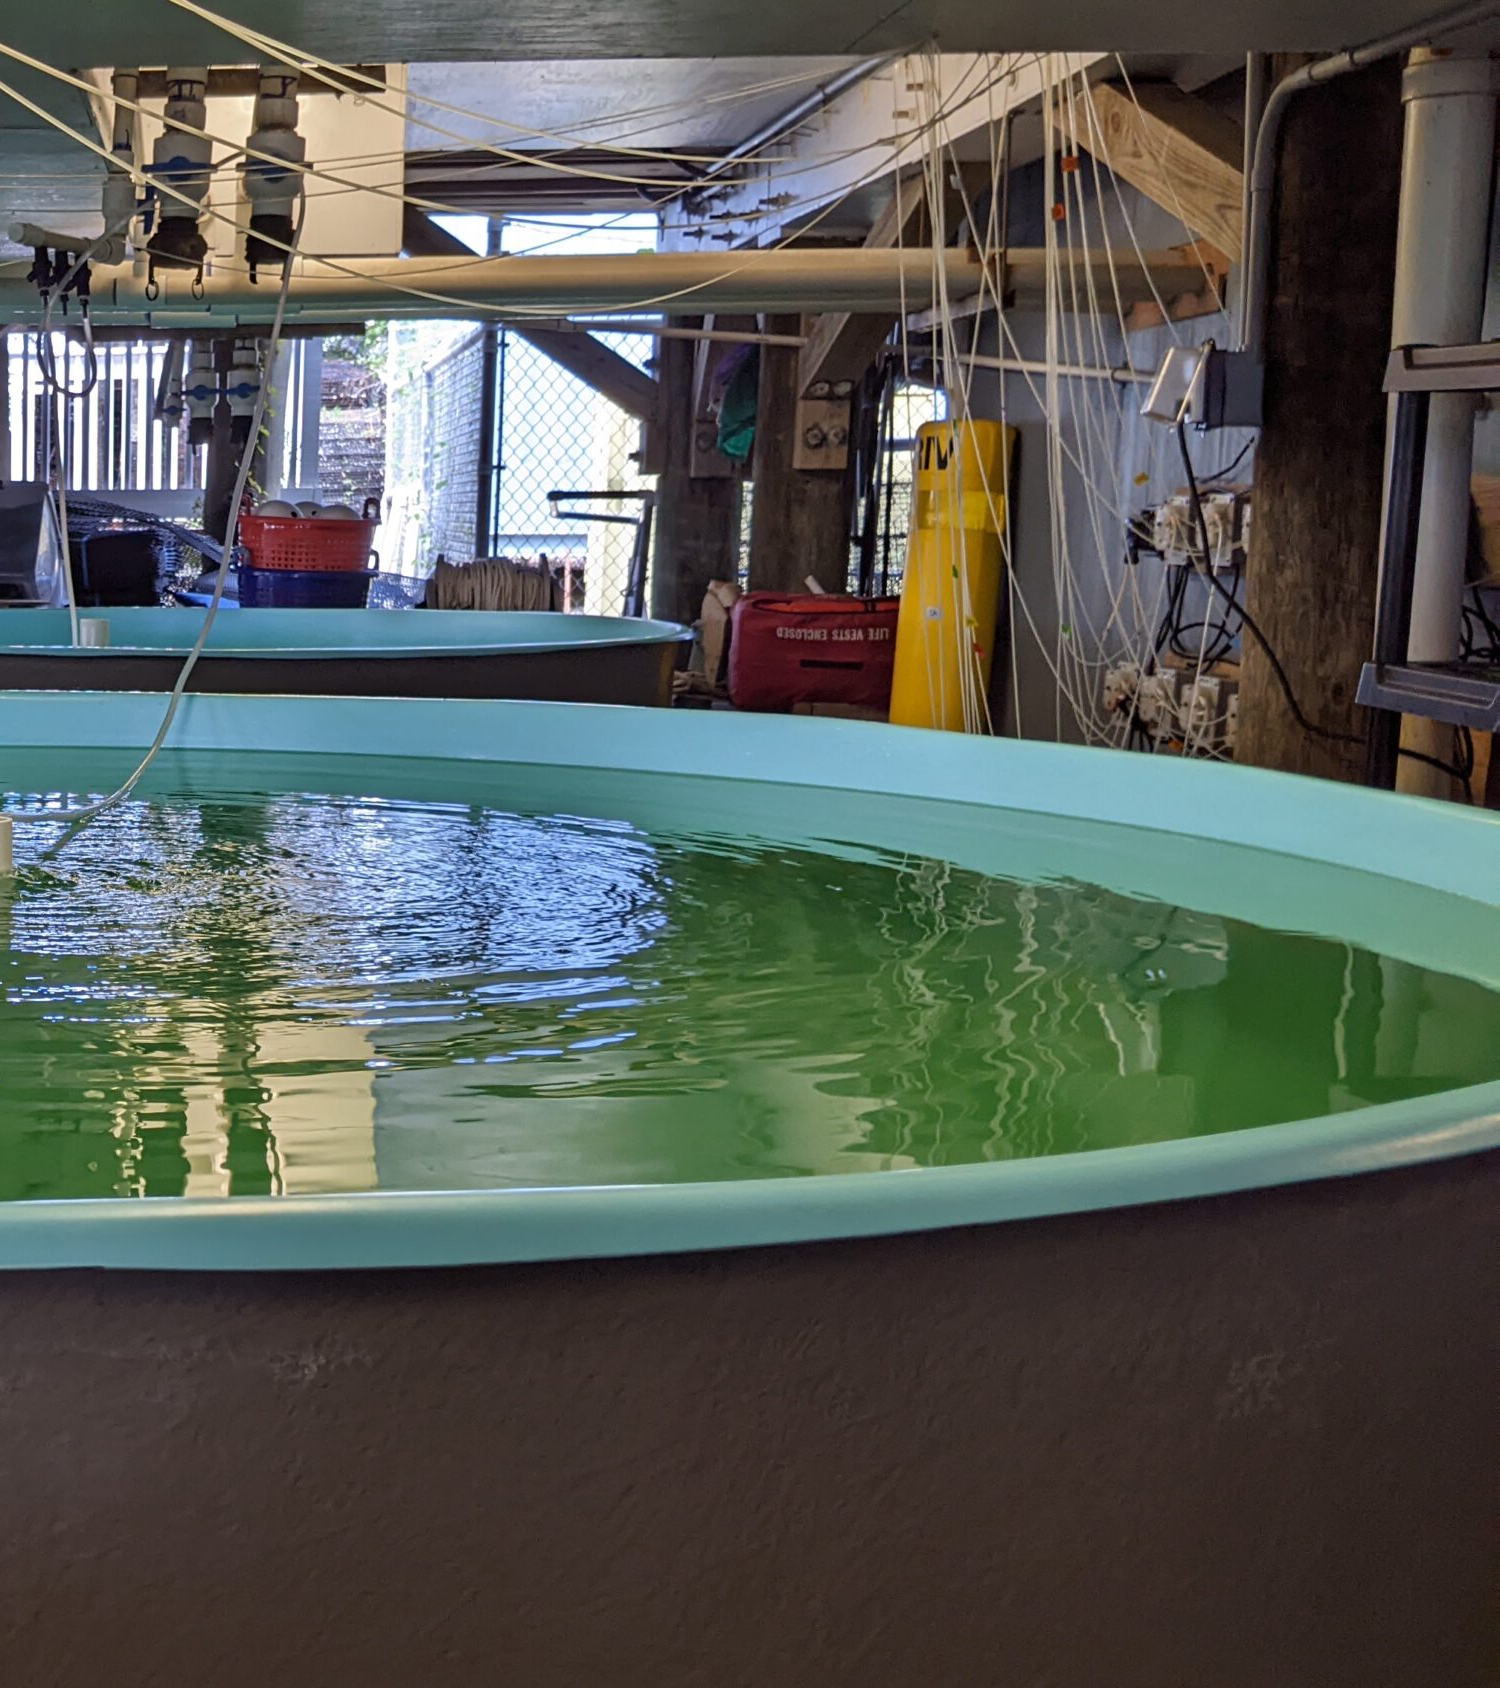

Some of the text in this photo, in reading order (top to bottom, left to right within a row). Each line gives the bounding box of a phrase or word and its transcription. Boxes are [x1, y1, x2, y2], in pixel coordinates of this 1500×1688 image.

[776, 626, 890, 641] LIFE VESTS ENCLOSED
